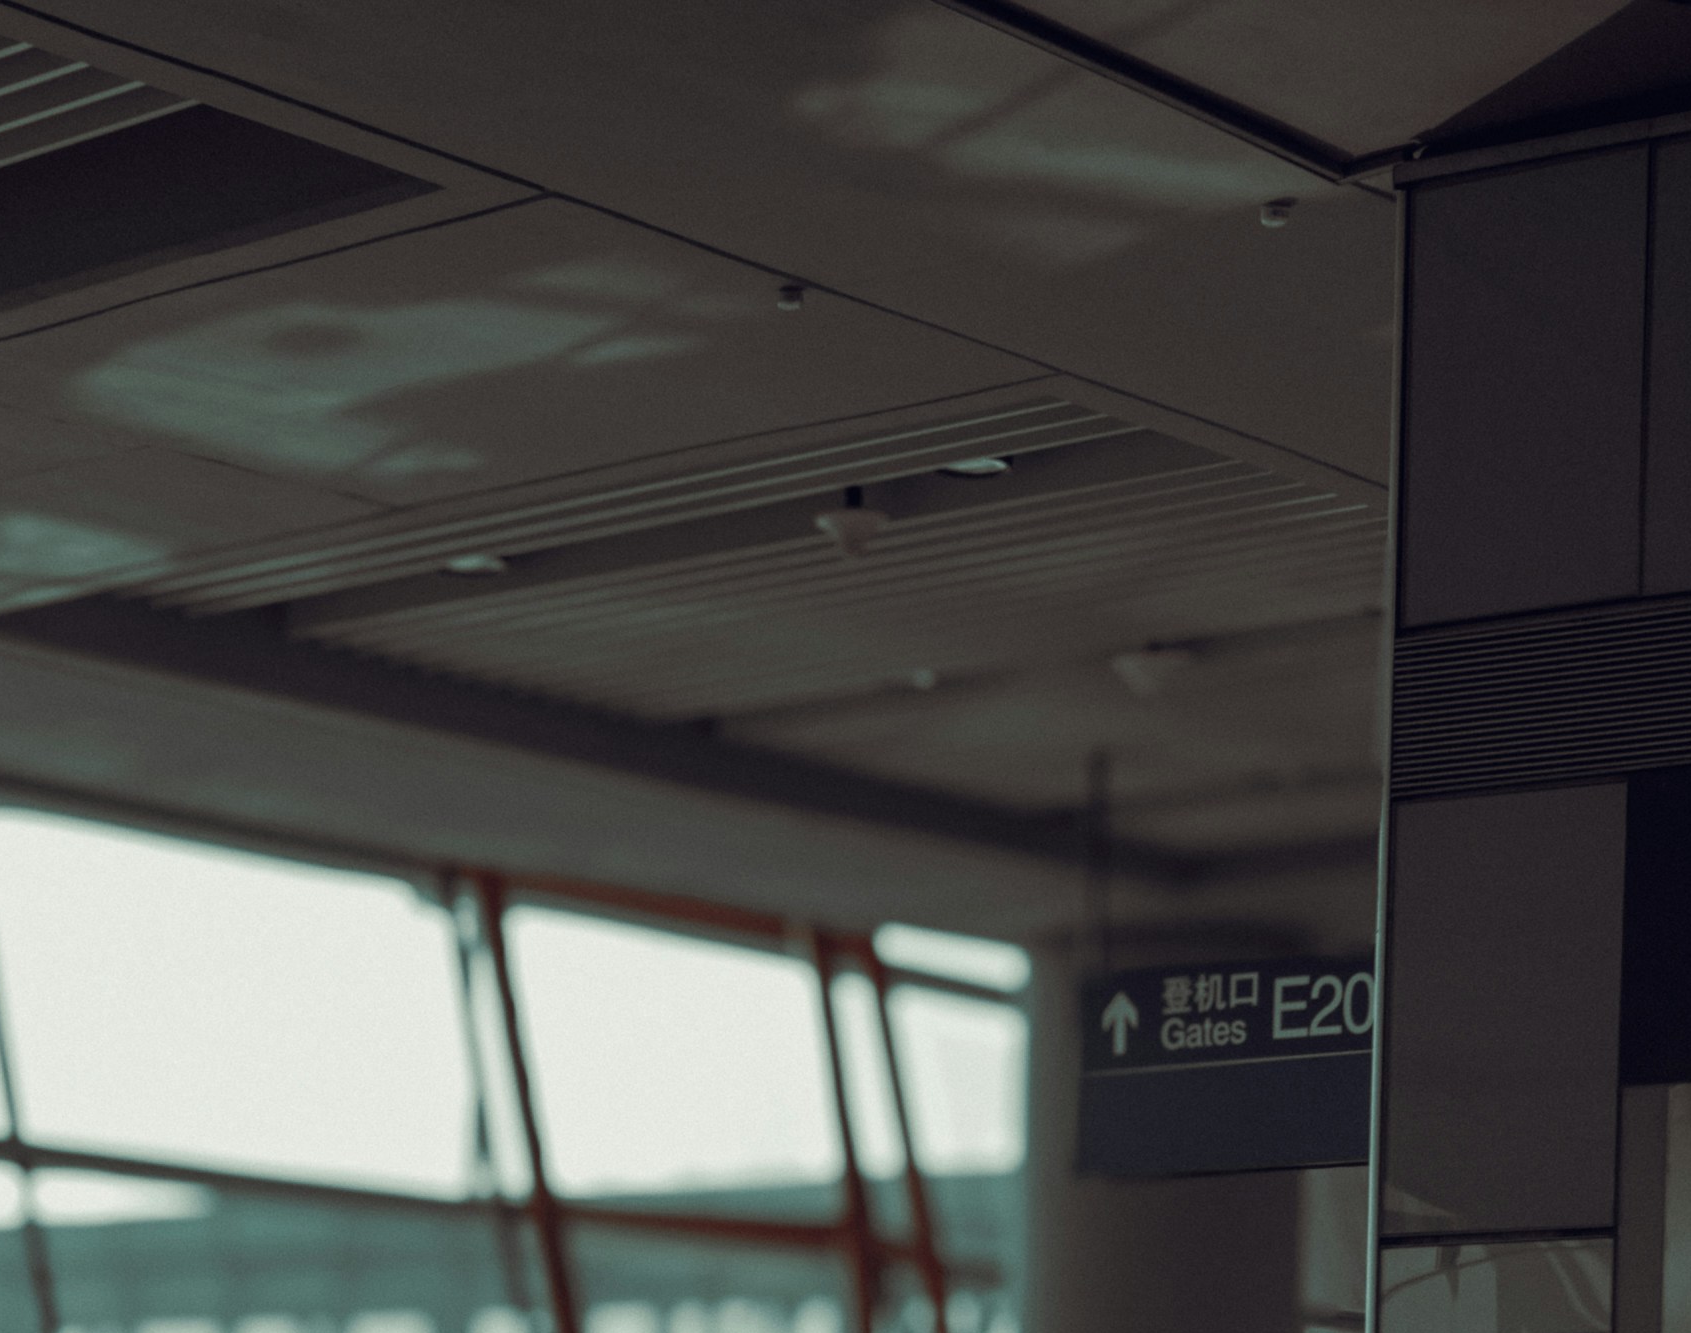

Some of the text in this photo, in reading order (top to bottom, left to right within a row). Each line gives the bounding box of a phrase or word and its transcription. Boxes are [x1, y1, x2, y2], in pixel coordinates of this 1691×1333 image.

[1162, 972, 1259, 1014] 登机口
[1273, 972, 1374, 1040] E20
[1161, 1017, 1247, 1050] Gates
